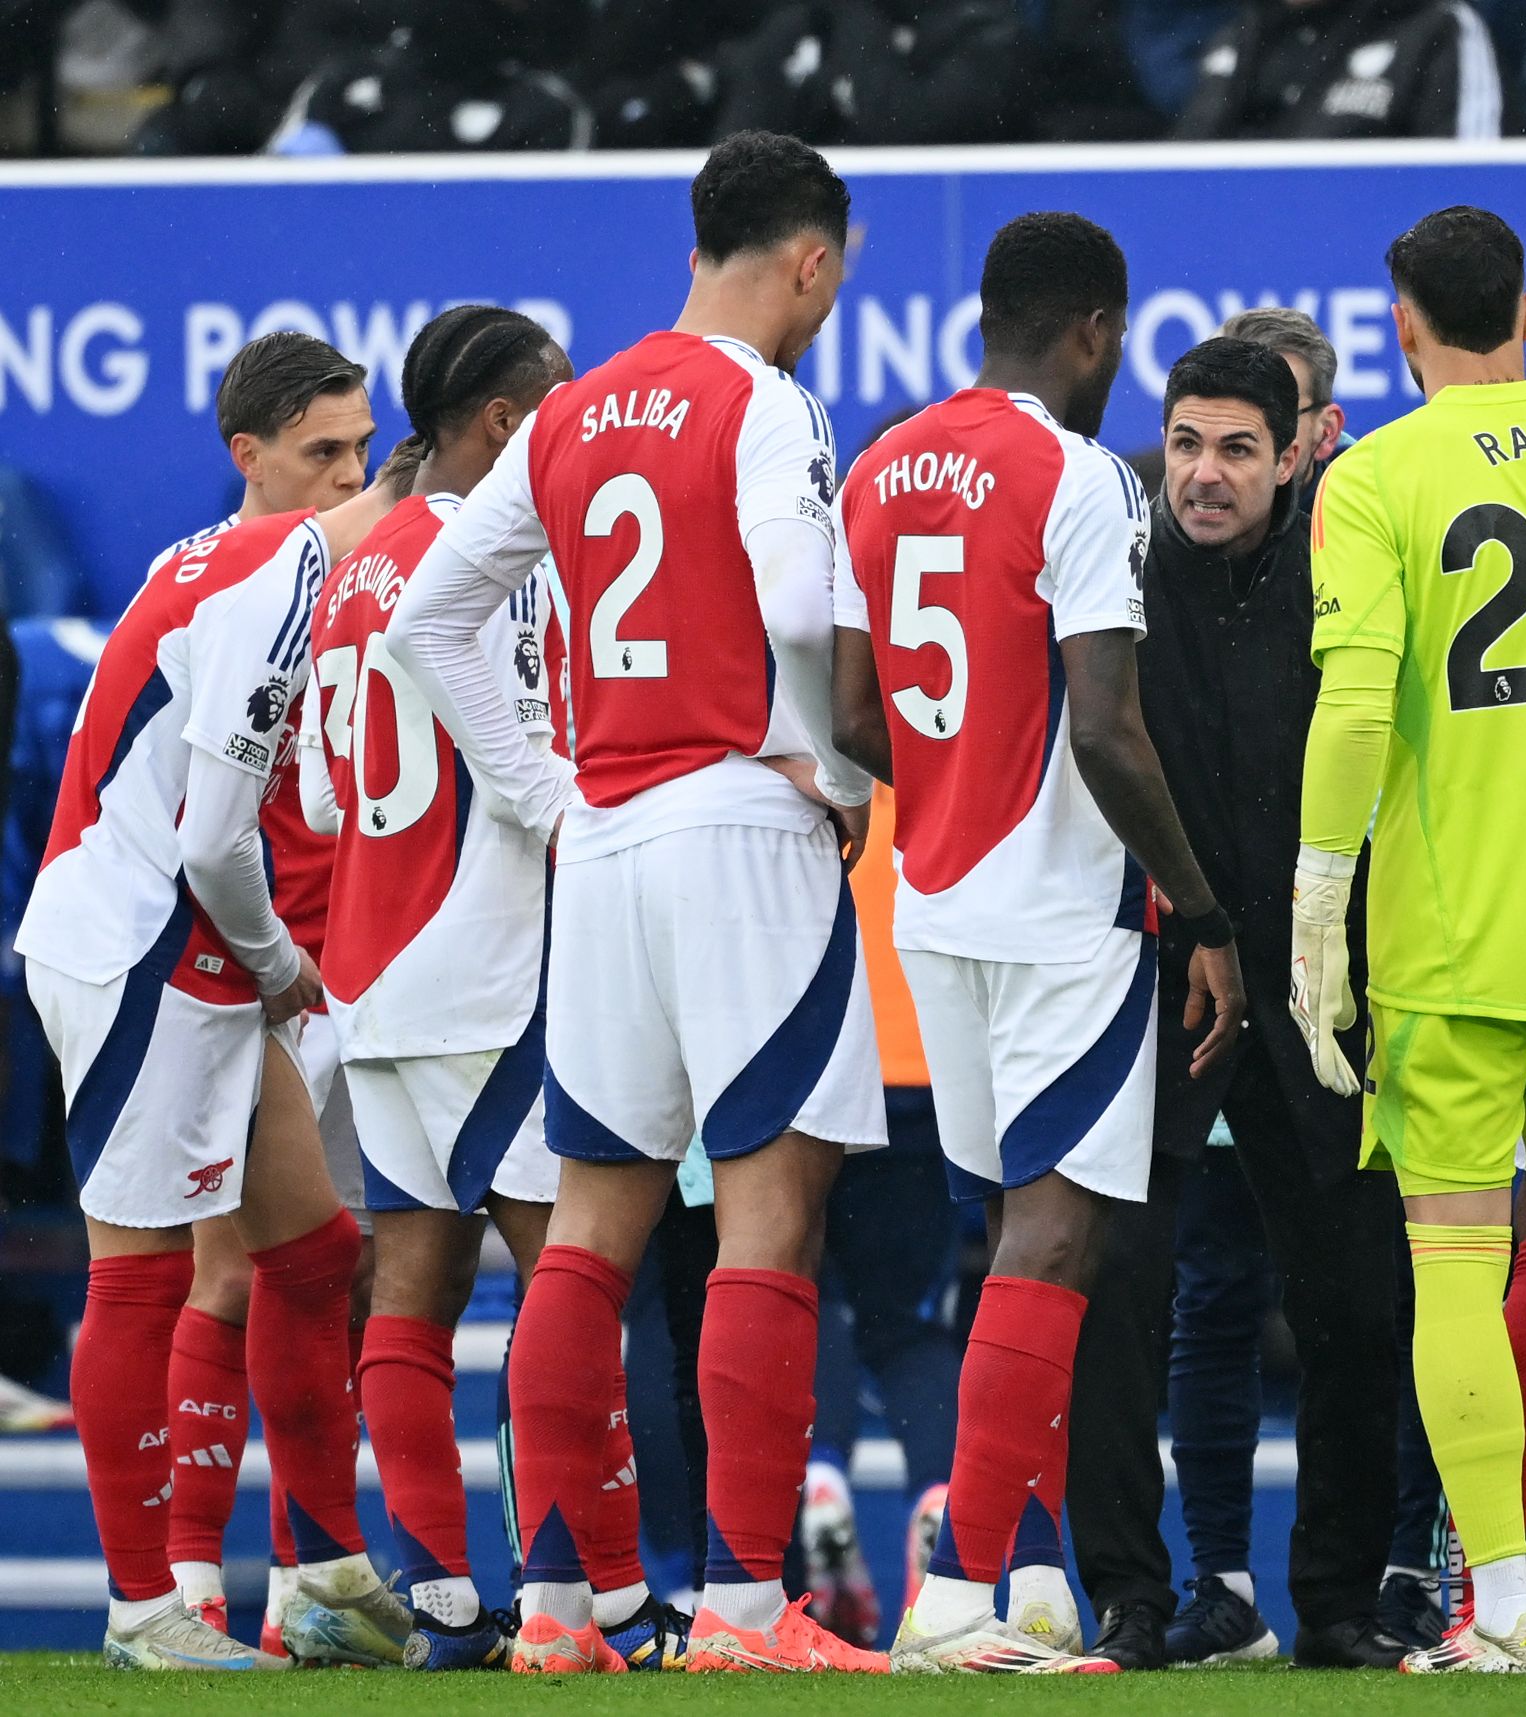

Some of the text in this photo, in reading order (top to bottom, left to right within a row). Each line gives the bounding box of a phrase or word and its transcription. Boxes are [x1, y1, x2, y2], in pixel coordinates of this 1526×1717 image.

[580, 387, 691, 443] SALIBA
[873, 451, 996, 510] THOMAS
[327, 552, 406, 635] STERLING
[582, 472, 668, 679] 2
[890, 534, 969, 740] 5
[315, 630, 440, 839] 30
[178, 1398, 237, 1420] AFC
